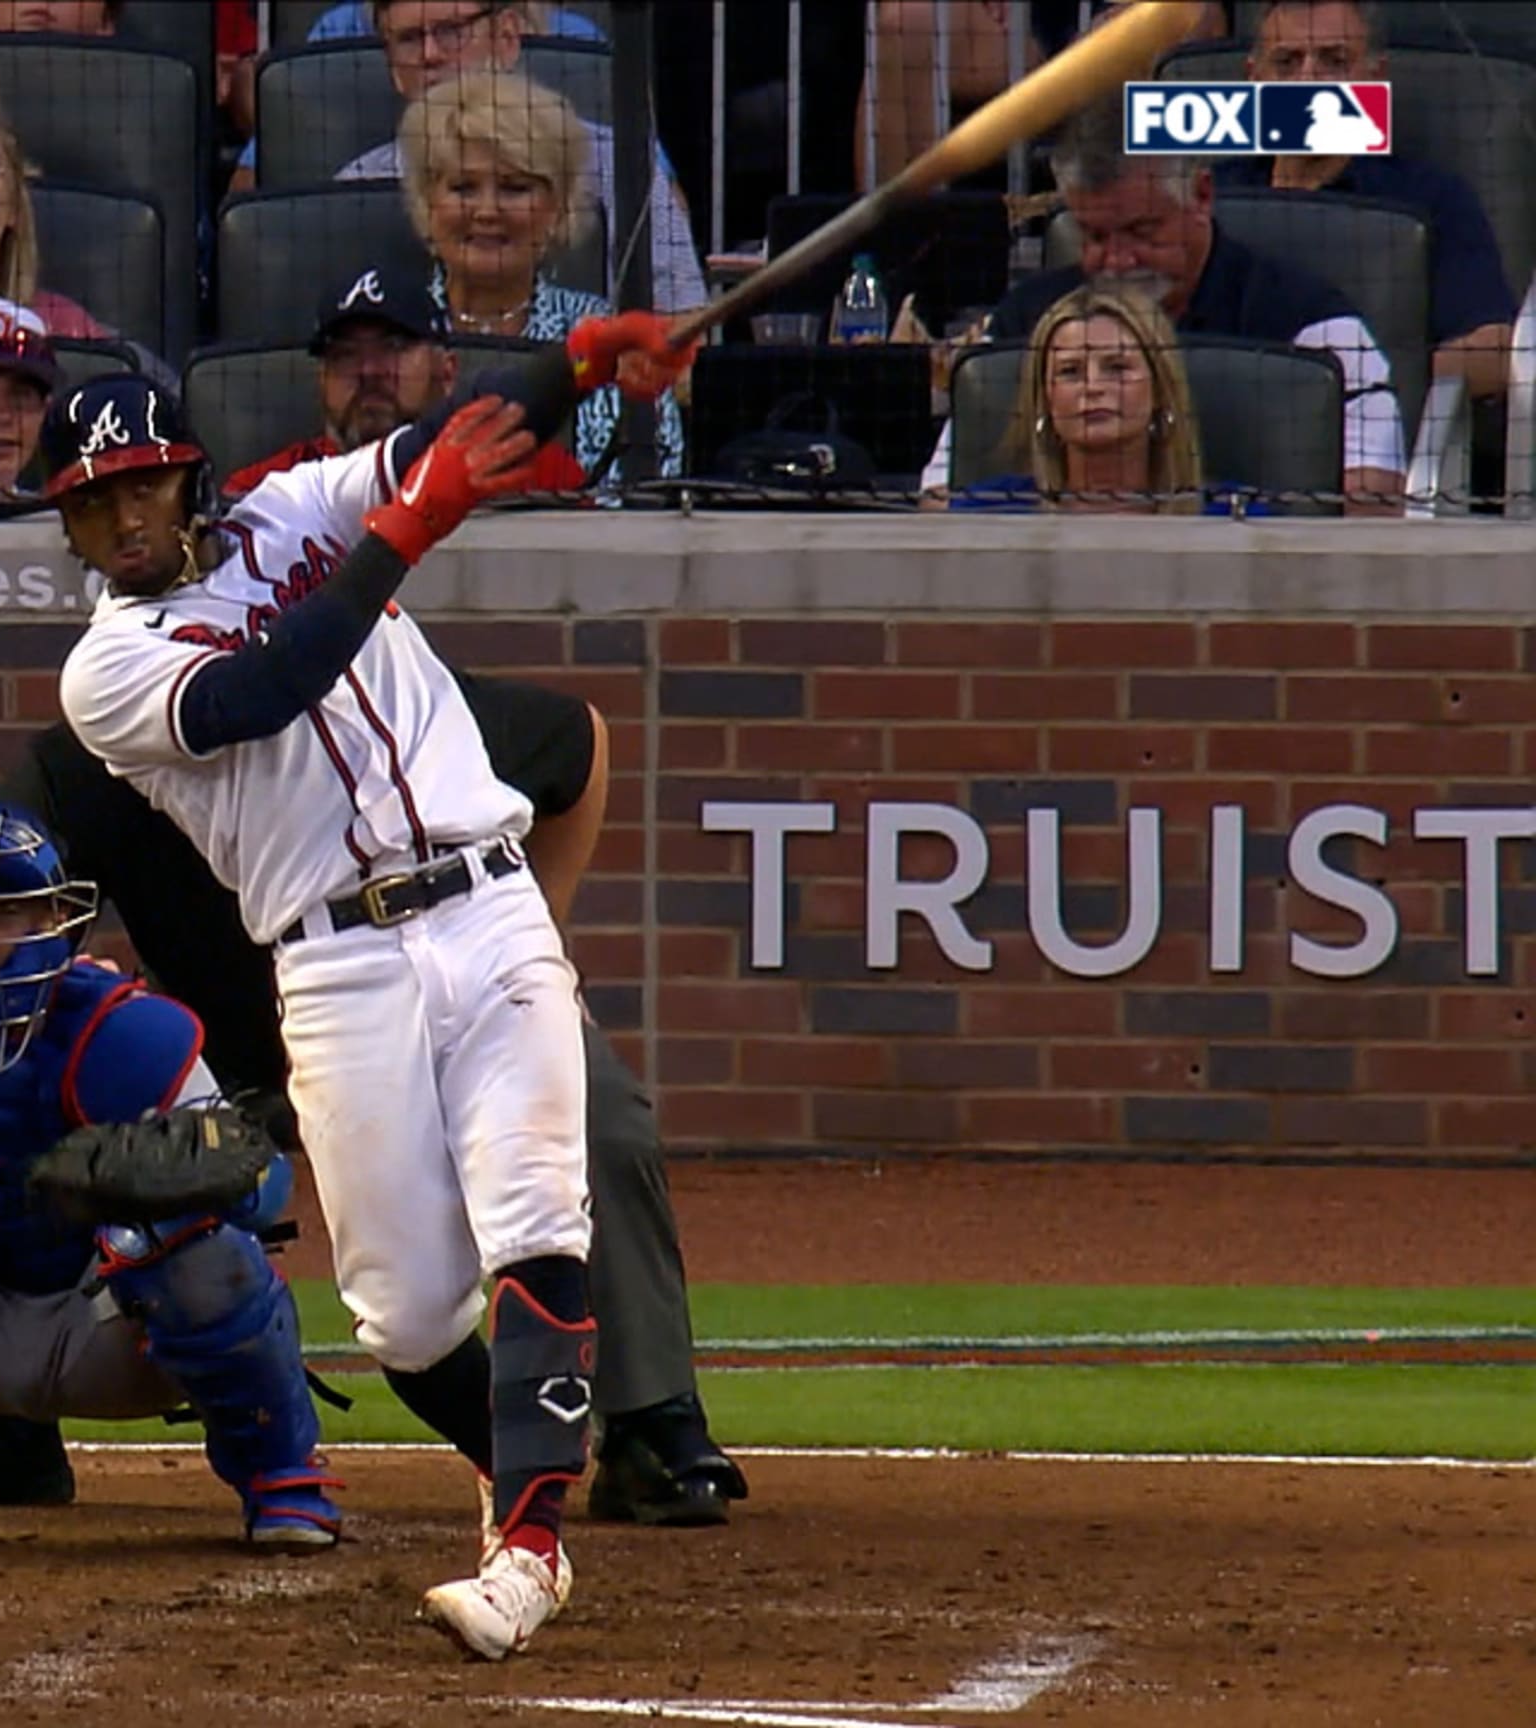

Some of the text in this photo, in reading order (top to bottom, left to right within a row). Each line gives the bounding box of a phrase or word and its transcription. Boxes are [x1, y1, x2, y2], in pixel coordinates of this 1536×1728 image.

[337, 269, 384, 310] A
[79, 400, 130, 454] A
[701, 802, 1536, 978] TRUIST
